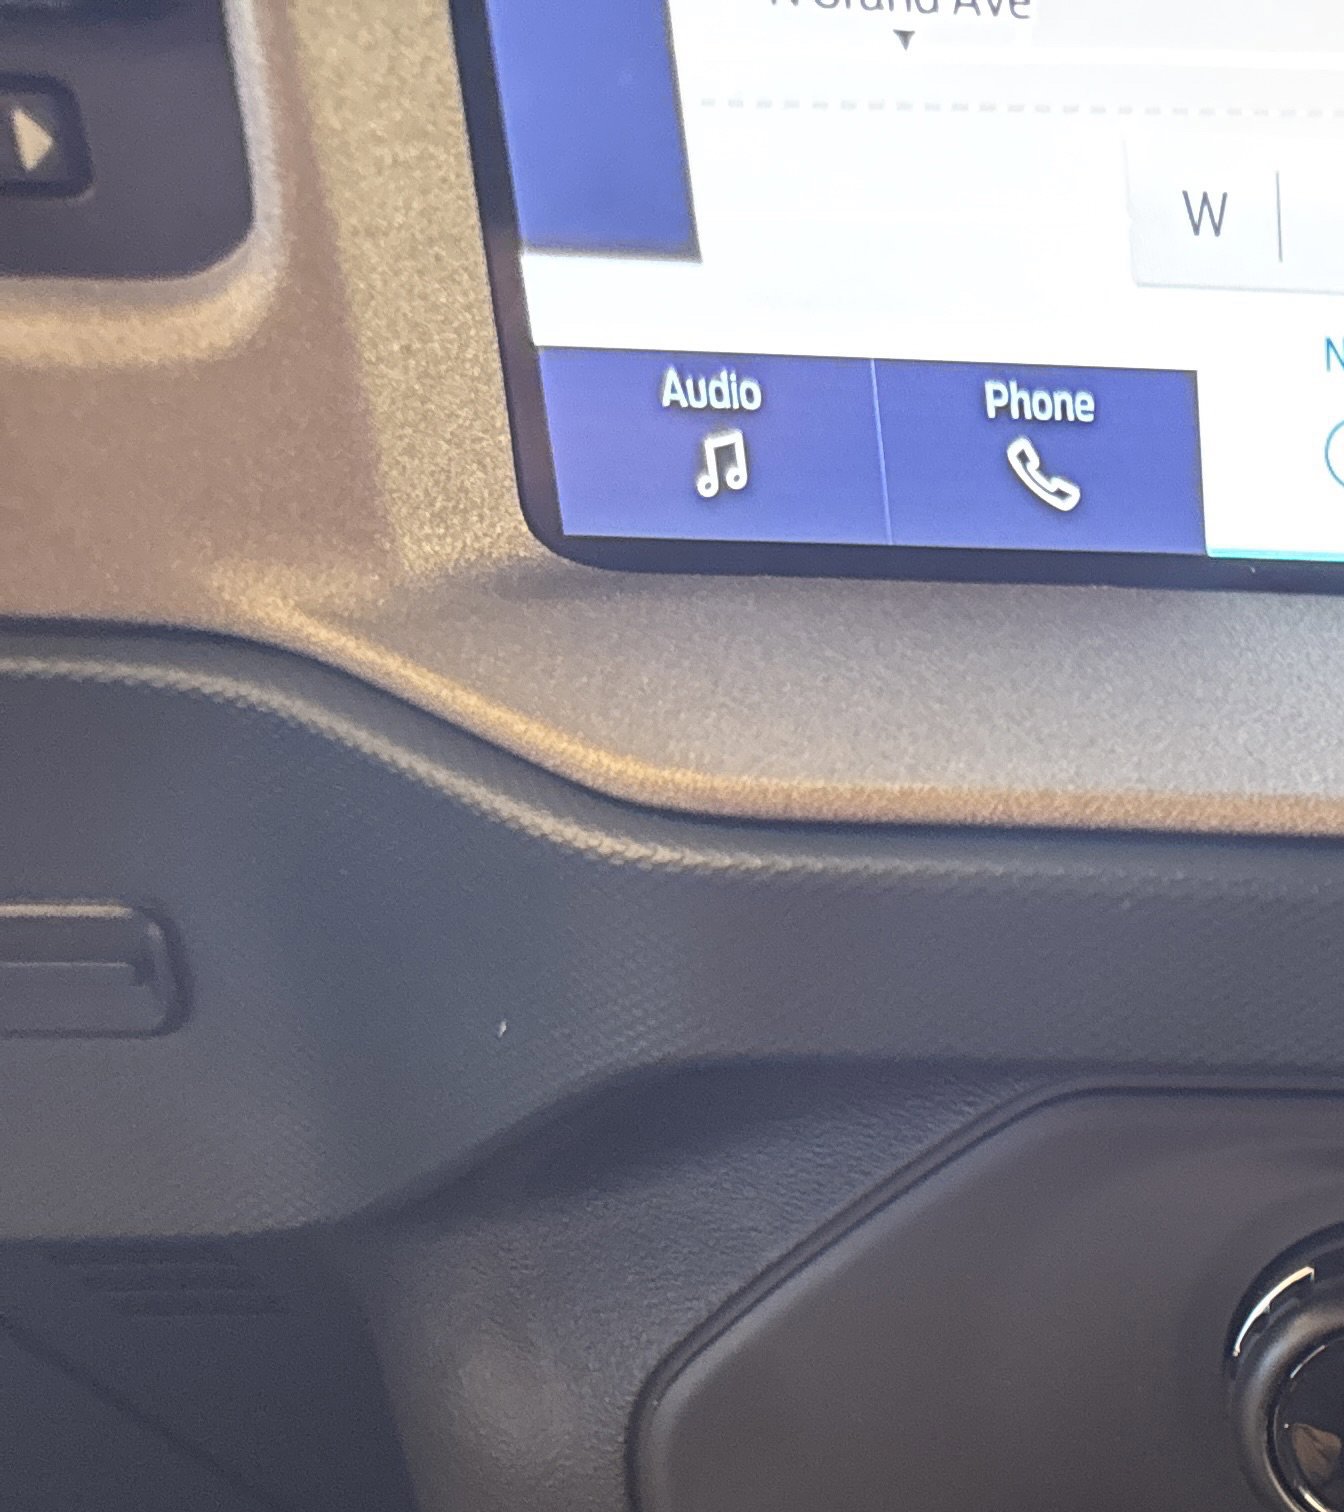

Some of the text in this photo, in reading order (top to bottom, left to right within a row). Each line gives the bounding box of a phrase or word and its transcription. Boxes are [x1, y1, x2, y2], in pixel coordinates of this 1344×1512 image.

[1181, 190, 1228, 238] W
[661, 366, 763, 412] Audio
[984, 379, 1096, 424] Phone
